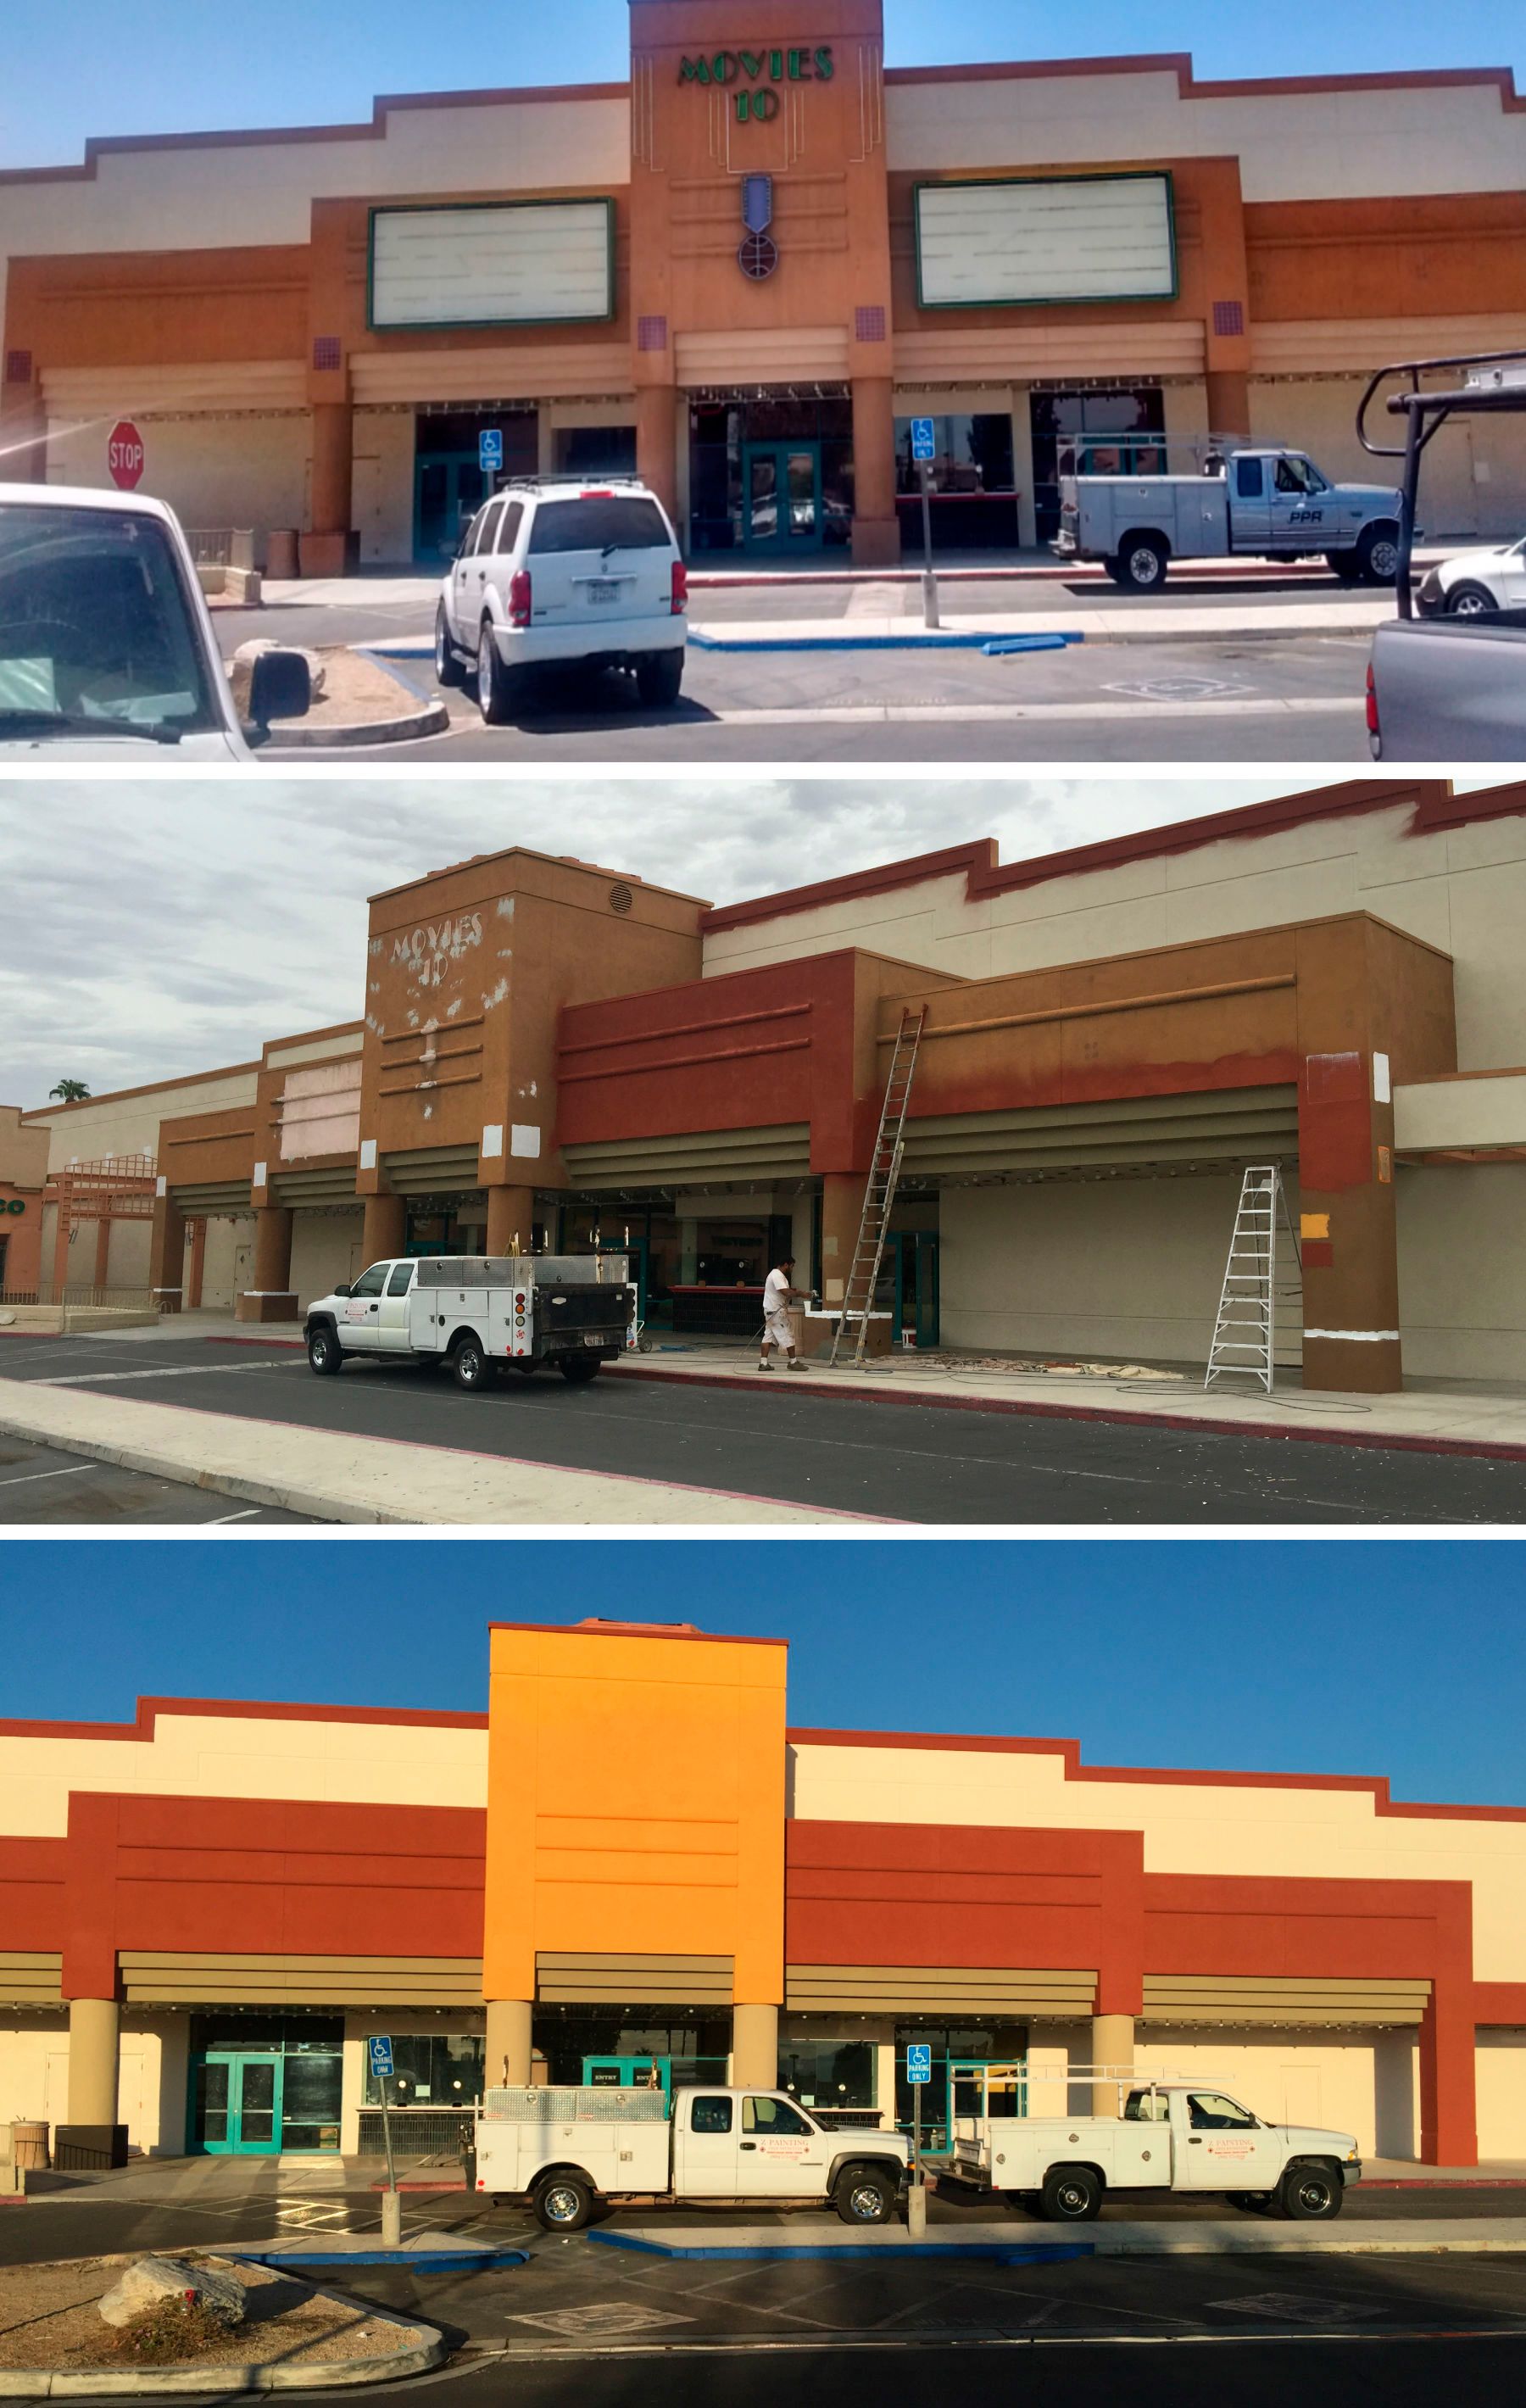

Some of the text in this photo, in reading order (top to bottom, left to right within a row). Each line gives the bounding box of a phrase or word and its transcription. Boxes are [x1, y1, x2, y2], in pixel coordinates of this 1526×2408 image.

[678, 47, 833, 86] MOVIES
[733, 88, 780, 122] 10
[110, 442, 142, 470] STOP
[1288, 510, 1323, 525] PPR
[390, 911, 483, 963] MOVIES
[909, 2064, 929, 2072] PARKING
[912, 2072, 926, 2081] ONLY
